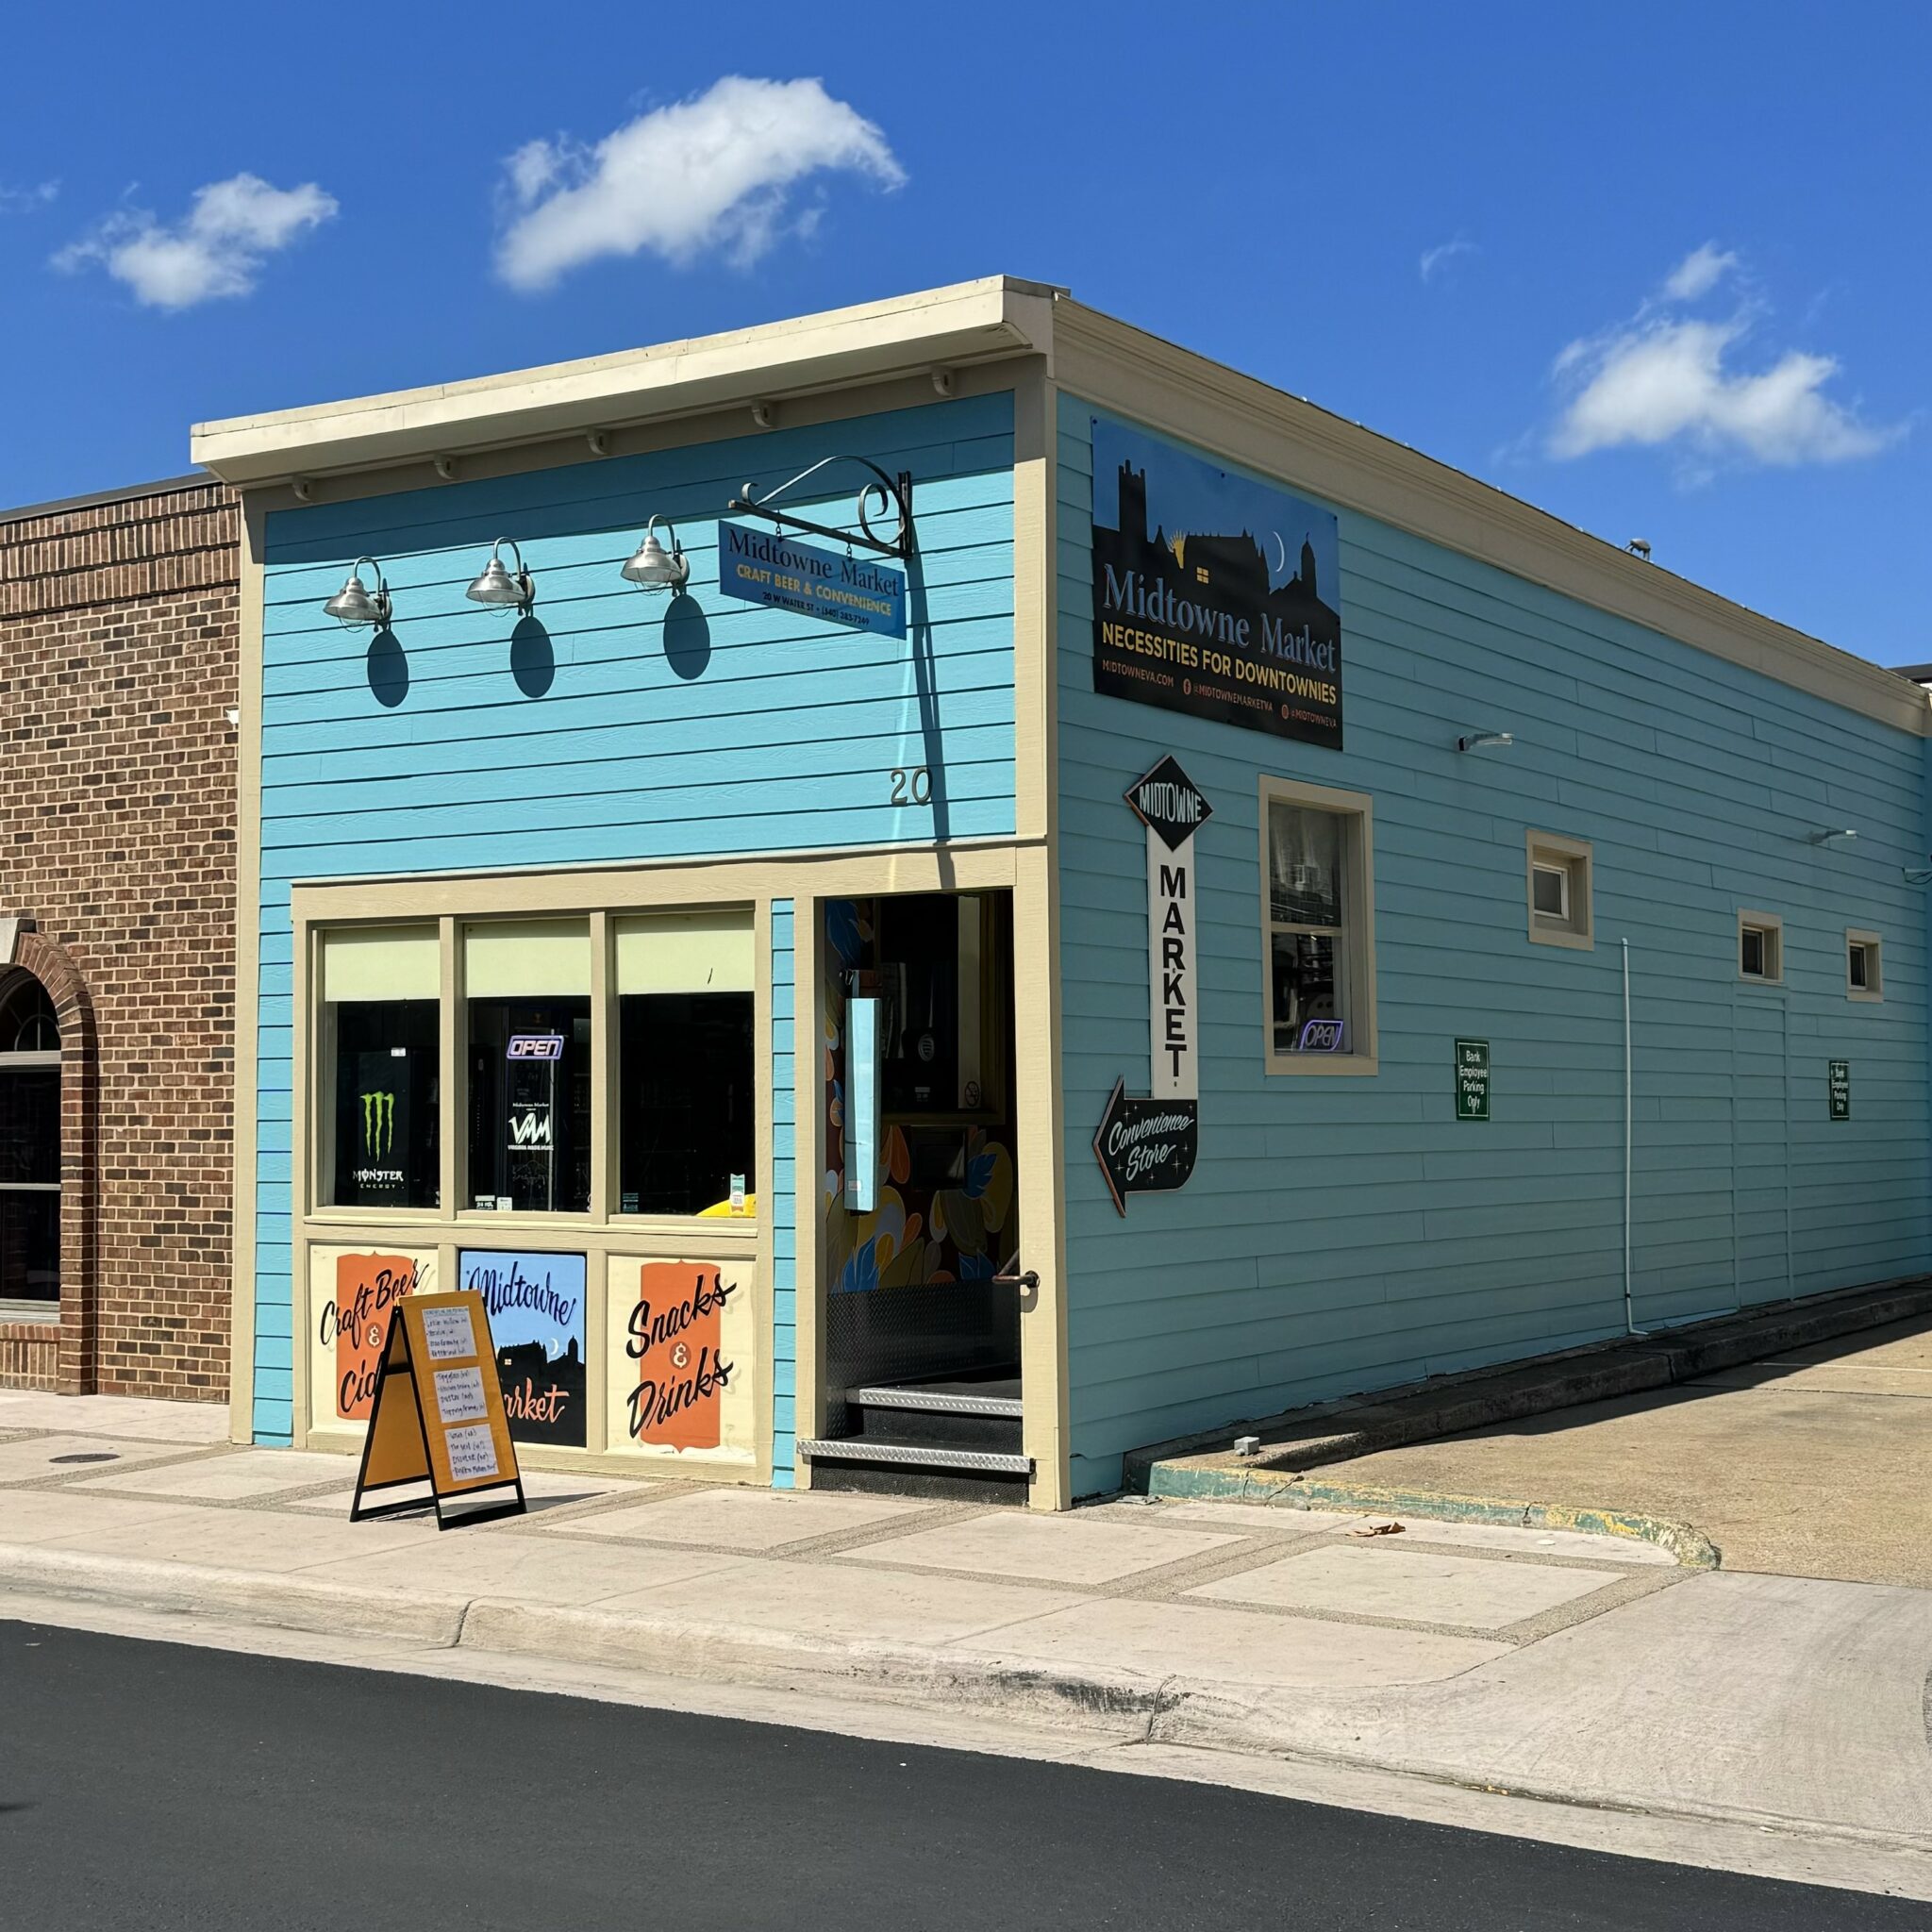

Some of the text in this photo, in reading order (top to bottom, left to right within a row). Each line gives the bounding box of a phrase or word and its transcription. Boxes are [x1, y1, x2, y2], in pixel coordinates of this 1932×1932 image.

[729, 528, 899, 597] Midtowne Market
[737, 564, 891, 617] CRAFT BEER & CONVENIENCE
[774, 593, 782, 604] W
[806, 602, 814, 611] ST
[1103, 563, 1336, 674] Midtowne Market
[1102, 621, 1337, 706] NECESSITIES FOR DOWNTOWNIES
[1102, 659, 1174, 688] MIDTOWNEVA.COM
[891, 767, 932, 808] 20
[1139, 782, 1202, 824] MIDTOWNE
[1158, 865, 1189, 1078] MARKET
[509, 1040, 560, 1057] OPEN
[1305, 1024, 1341, 1047] OPEN
[1466, 1049, 1481, 1063] Bank
[1459, 1064, 1488, 1079] Employee
[1463, 1080, 1485, 1095] Parking
[1467, 1094, 1481, 1109] Only
[1108, 1111, 1195, 1157] Convenience
[352, 1168, 404, 1182] MONSTER
[1125, 1143, 1177, 1181] Store
[320, 1258, 429, 1350] Craft Beer
[466, 1260, 576, 1325] Midtowne
[369, 1324, 380, 1347] &
[626, 1274, 737, 1358] Snacks
[673, 1342, 688, 1368] &
[341, 1351, 384, 1413] Cid
[504, 1377, 570, 1424] arket
[626, 1346, 734, 1439] Drinks
